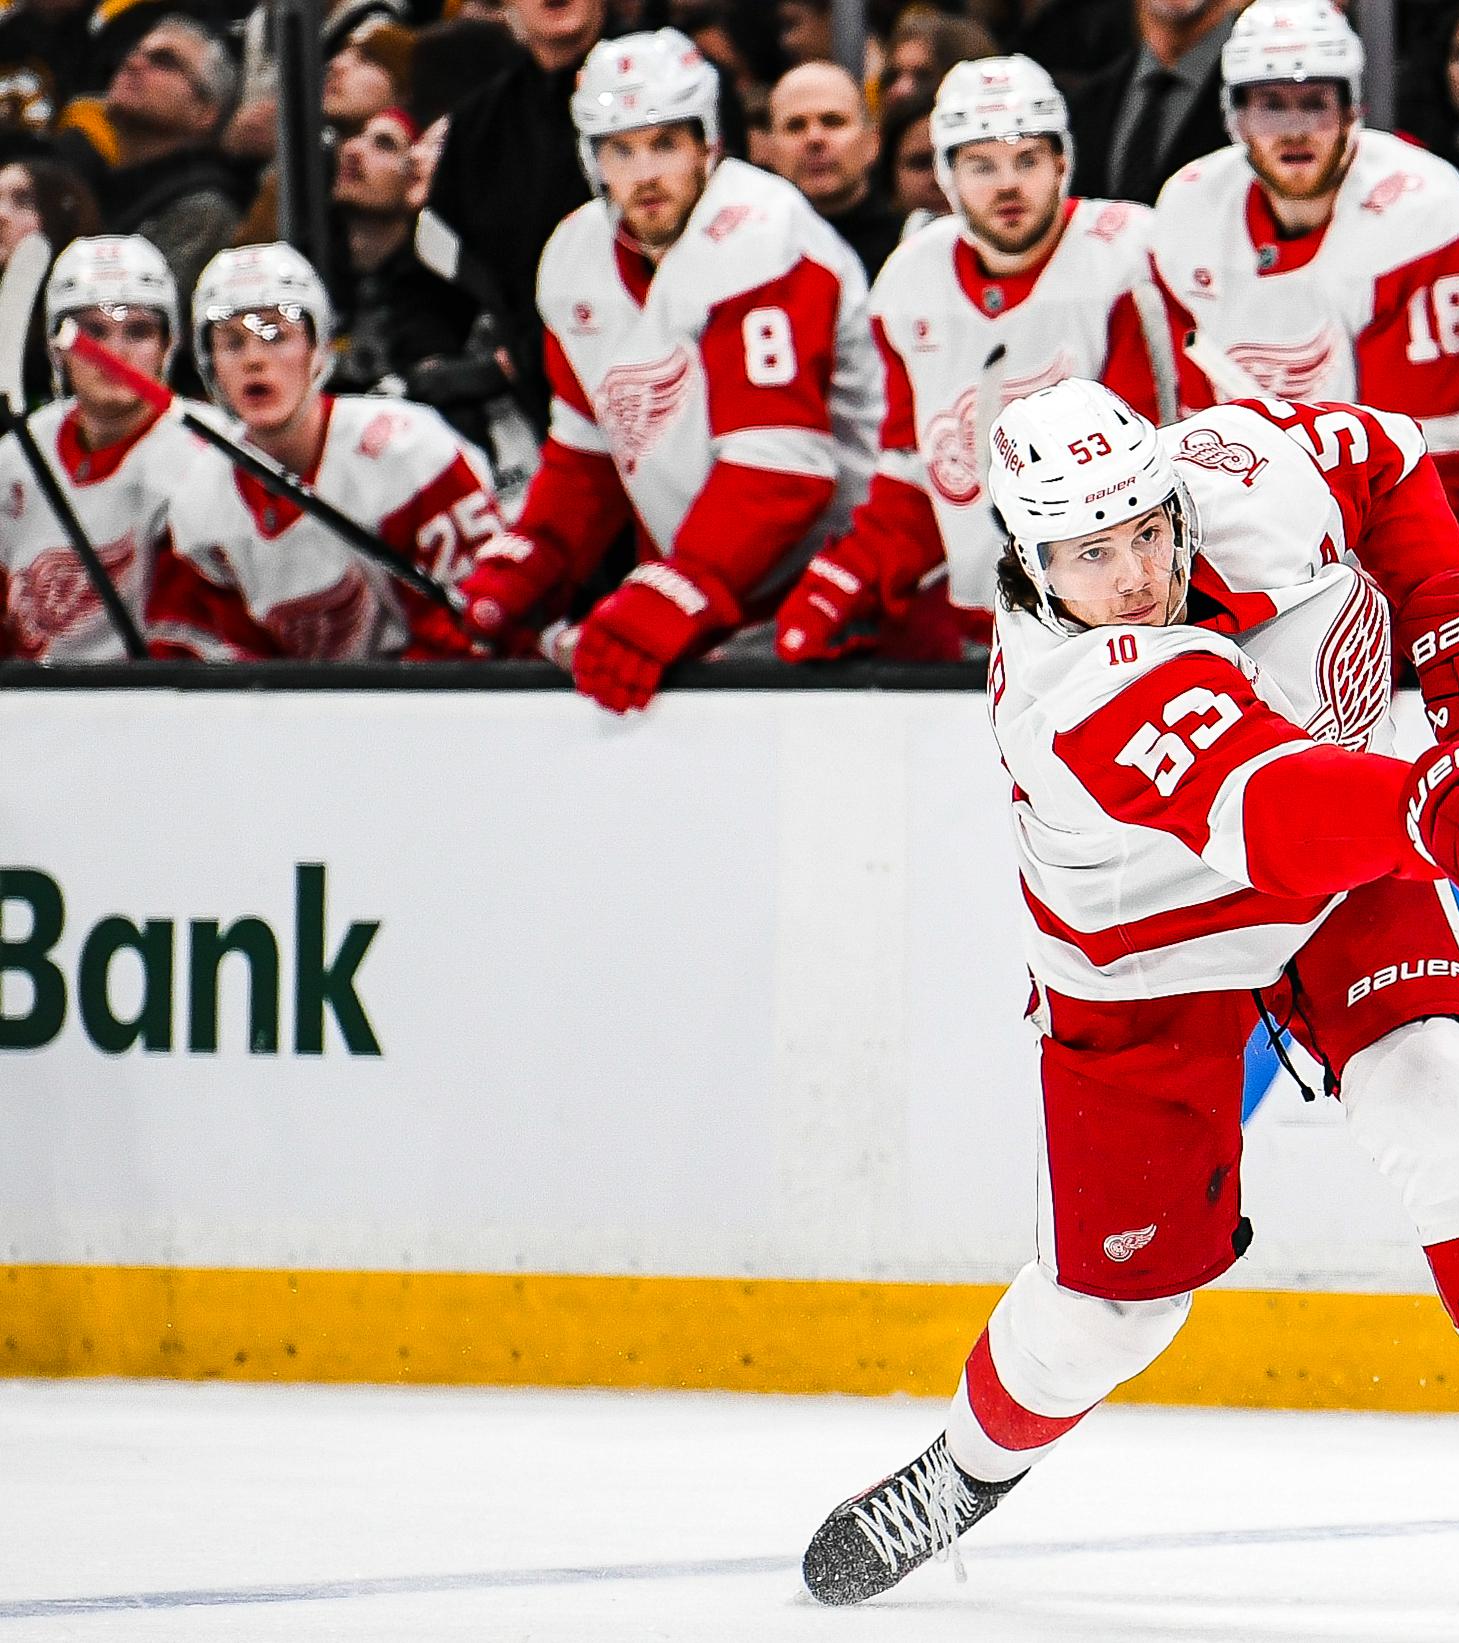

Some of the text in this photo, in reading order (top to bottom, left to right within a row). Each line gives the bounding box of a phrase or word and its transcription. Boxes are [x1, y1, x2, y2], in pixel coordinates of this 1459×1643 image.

[741, 306, 799, 388] 8
[993, 425, 1026, 477] meijer
[1067, 432, 1113, 465] 53
[1106, 633, 1139, 666] 10
[1113, 686, 1245, 797] 53
[0, 861, 383, 1058] Bank
